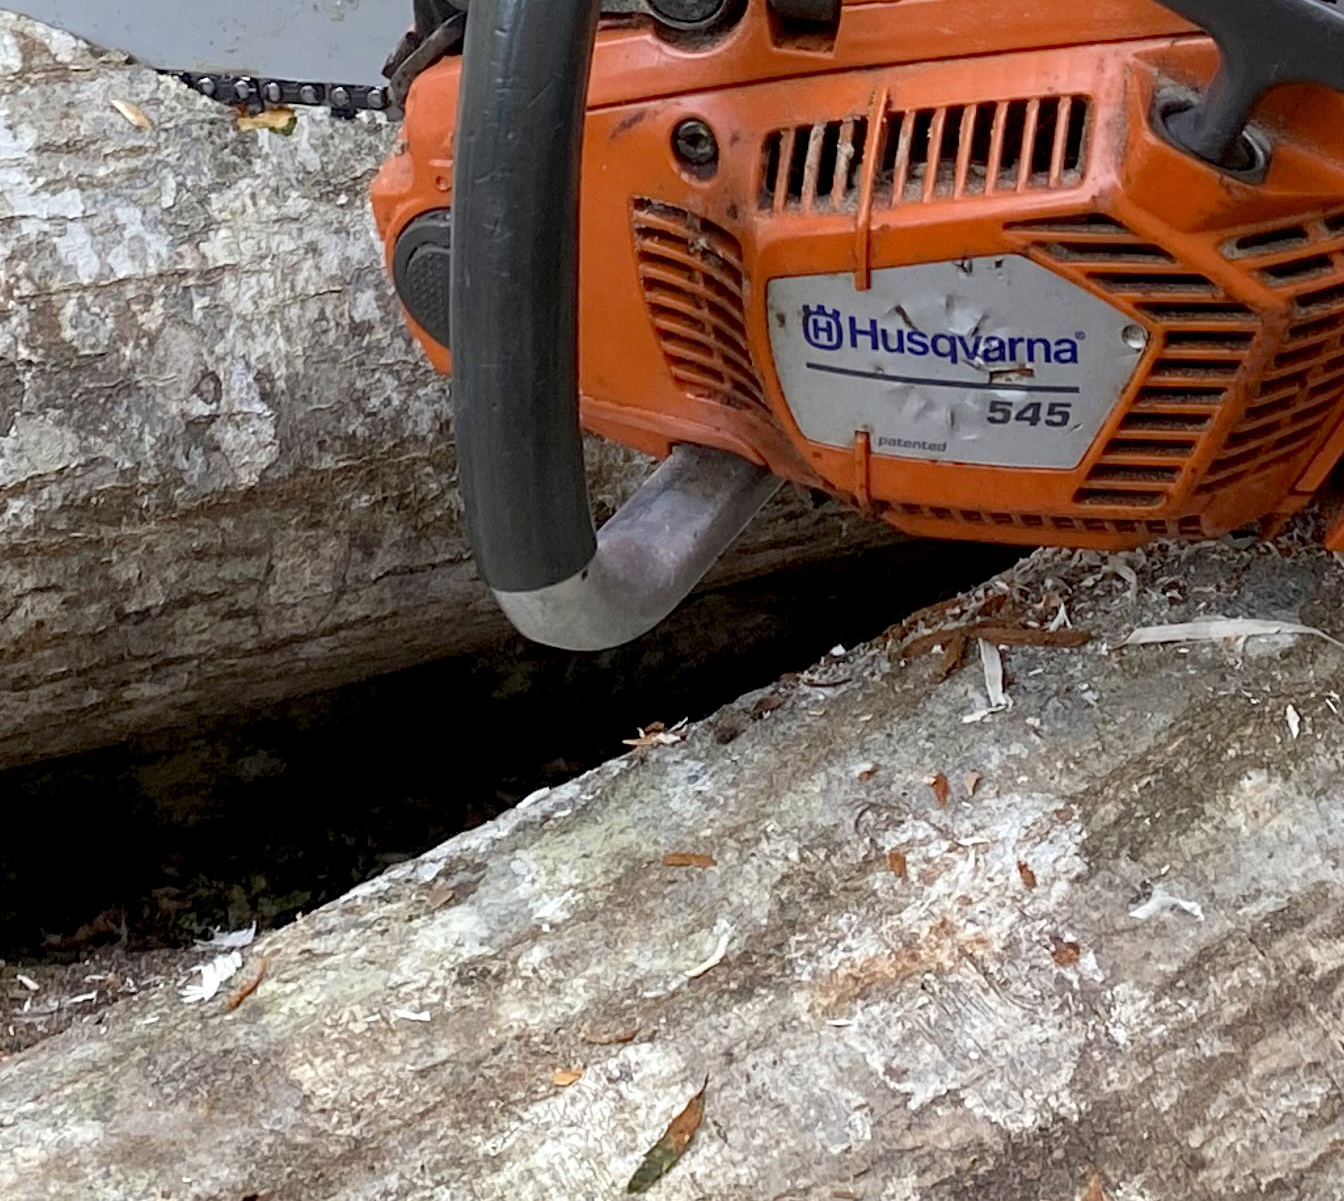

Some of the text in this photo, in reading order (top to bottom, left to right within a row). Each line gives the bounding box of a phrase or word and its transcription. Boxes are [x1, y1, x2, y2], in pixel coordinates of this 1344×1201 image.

[849, 315, 1079, 365] Husqvarna
[987, 401, 1072, 428] 545
[878, 435, 947, 453] patented
